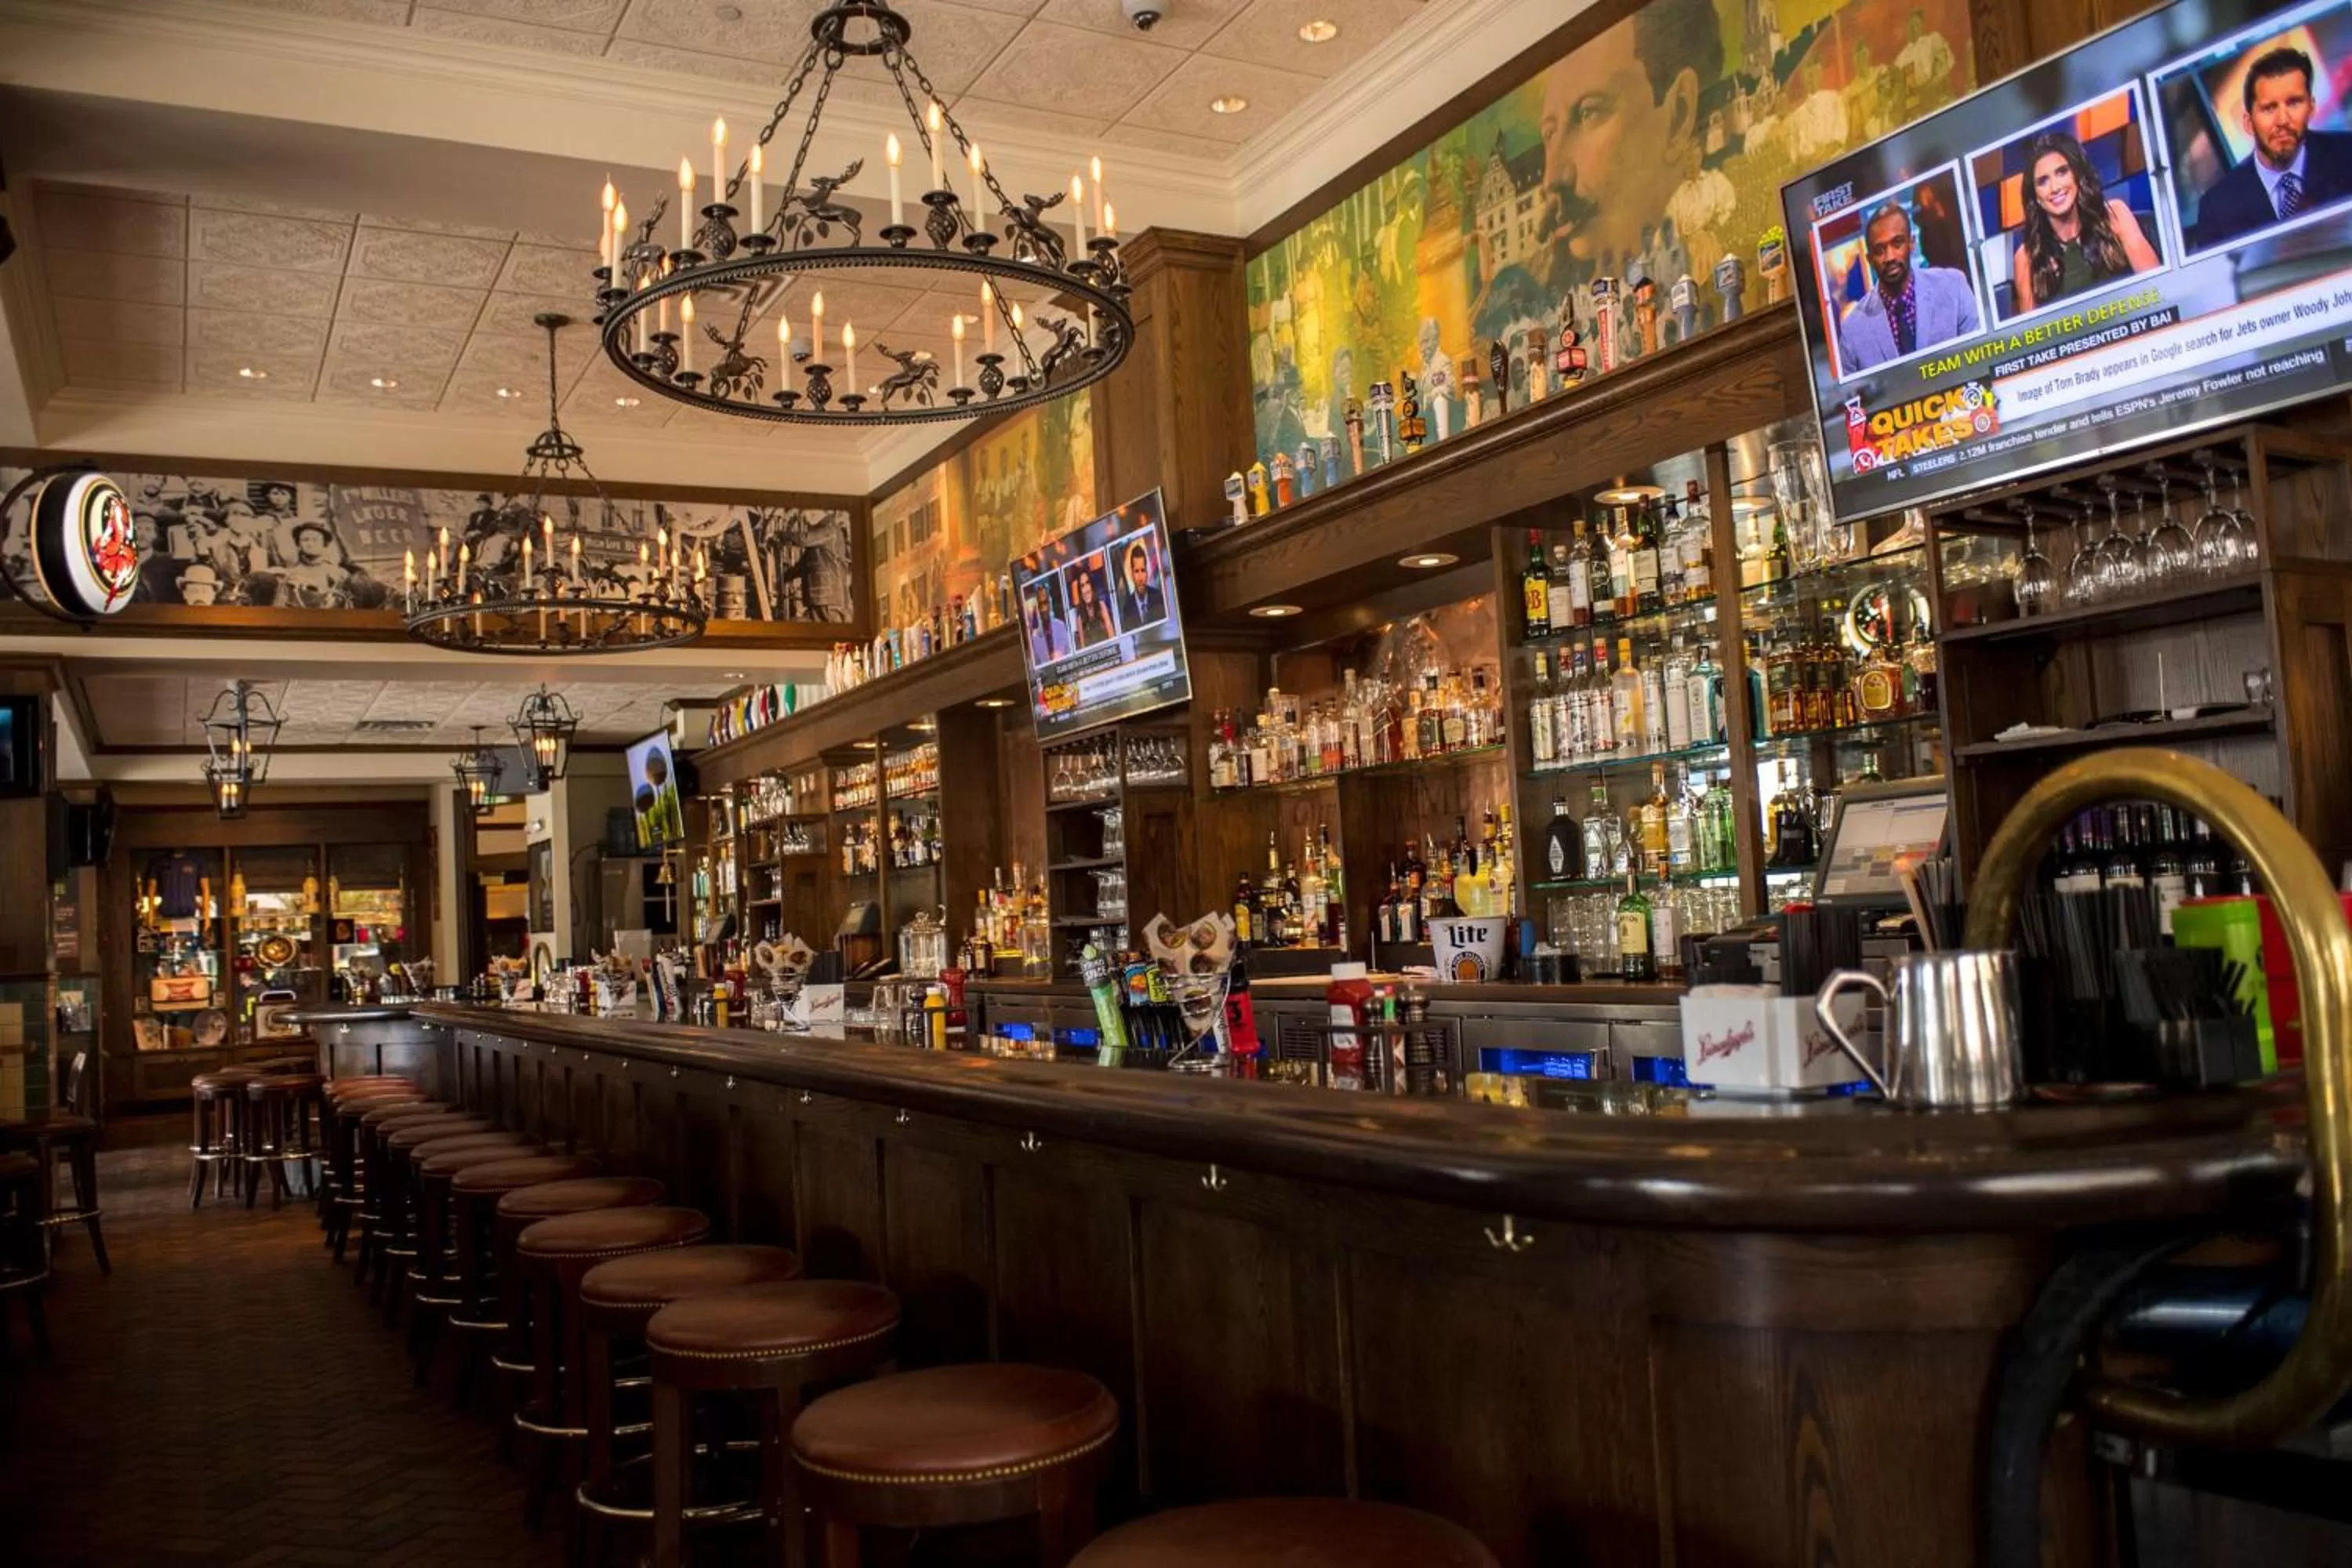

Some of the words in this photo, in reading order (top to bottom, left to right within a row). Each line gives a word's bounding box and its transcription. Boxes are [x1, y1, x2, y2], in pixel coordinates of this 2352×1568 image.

[1919, 354, 1961, 380] TEAM
[1964, 339, 2005, 365] WITH
[2009, 336, 2022, 350] A
[2024, 314, 2083, 344] BETTER
[1994, 358, 2025, 377] FIRST
[2027, 348, 2057, 364] TAKE
[2060, 325, 2129, 357] PRESENTED
[2130, 318, 2148, 333] BY
[2150, 310, 2172, 327] BAI
[2017, 387, 2043, 402] Image
[2044, 379, 2054, 394] of
[2054, 376, 2074, 393] Tom
[2074, 368, 2100, 386] Brady
[2103, 356, 2139, 379] appears
[2140, 350, 2149, 365] in
[2151, 340, 2183, 364] Google
[2185, 331, 2218, 351] search
[2219, 324, 2234, 339] for
[2236, 319, 2257, 337] Jets
[2259, 310, 2292, 328] owner
[2293, 296, 2329, 320] Woody
[1871, 386, 1968, 434] QUICK
[1988, 433, 2033, 452] franchise
[2034, 423, 2067, 439] tender
[2069, 414, 2091, 430] and
[2116, 397, 2157, 418] ESPN's
[2159, 384, 2201, 405] Jeremy
[2203, 372, 2243, 393] Fowler
[2245, 364, 2267, 382] not
[2268, 349, 2325, 376] reaching
[1875, 416, 1974, 461] TAKES
[1448, 926, 1487, 948] Lite
